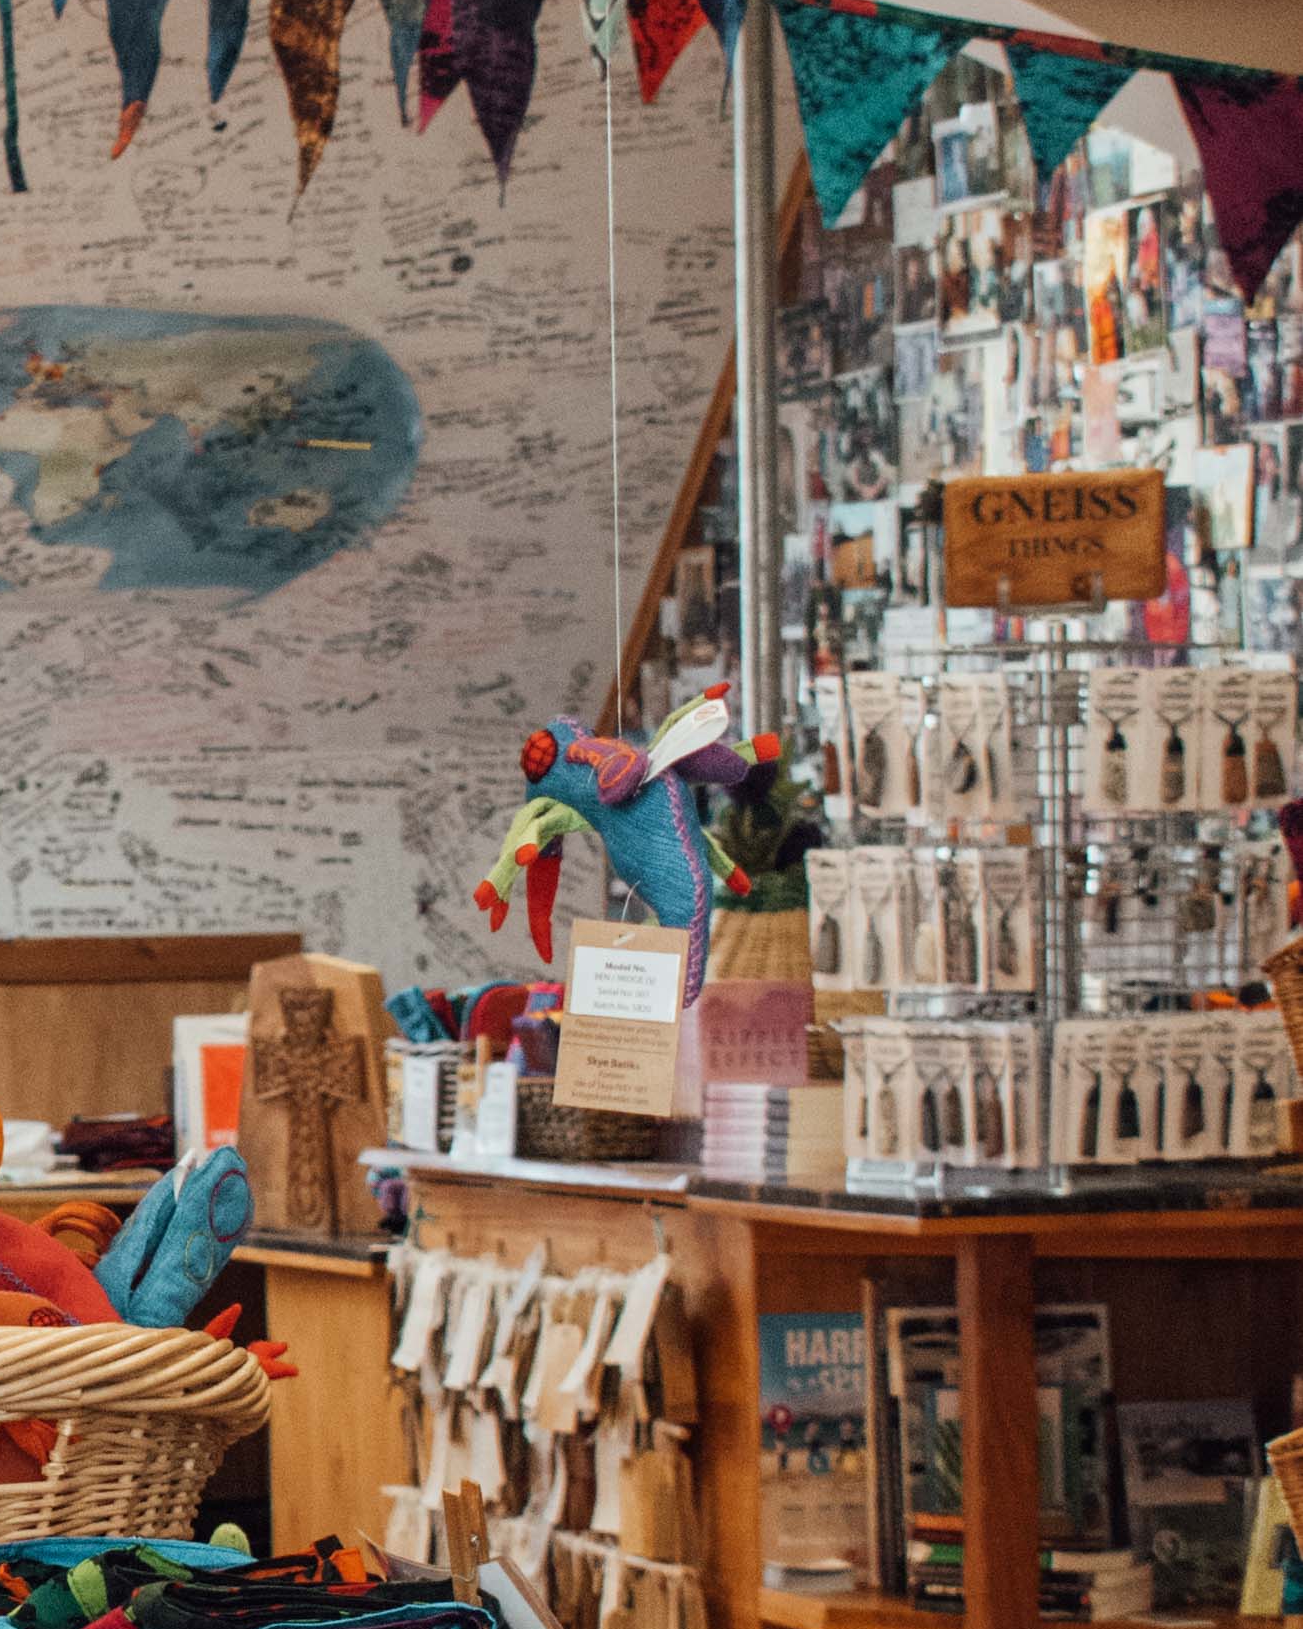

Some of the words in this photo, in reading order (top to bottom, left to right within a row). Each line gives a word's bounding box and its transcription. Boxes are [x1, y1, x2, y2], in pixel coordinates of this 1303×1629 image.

[972, 483, 1139, 525] GNEISS
[1007, 535, 1106, 559] THINGS
[605, 961, 631, 972] Model
[587, 1056, 609, 1069] Skye
[611, 1058, 639, 1070] Batiks
